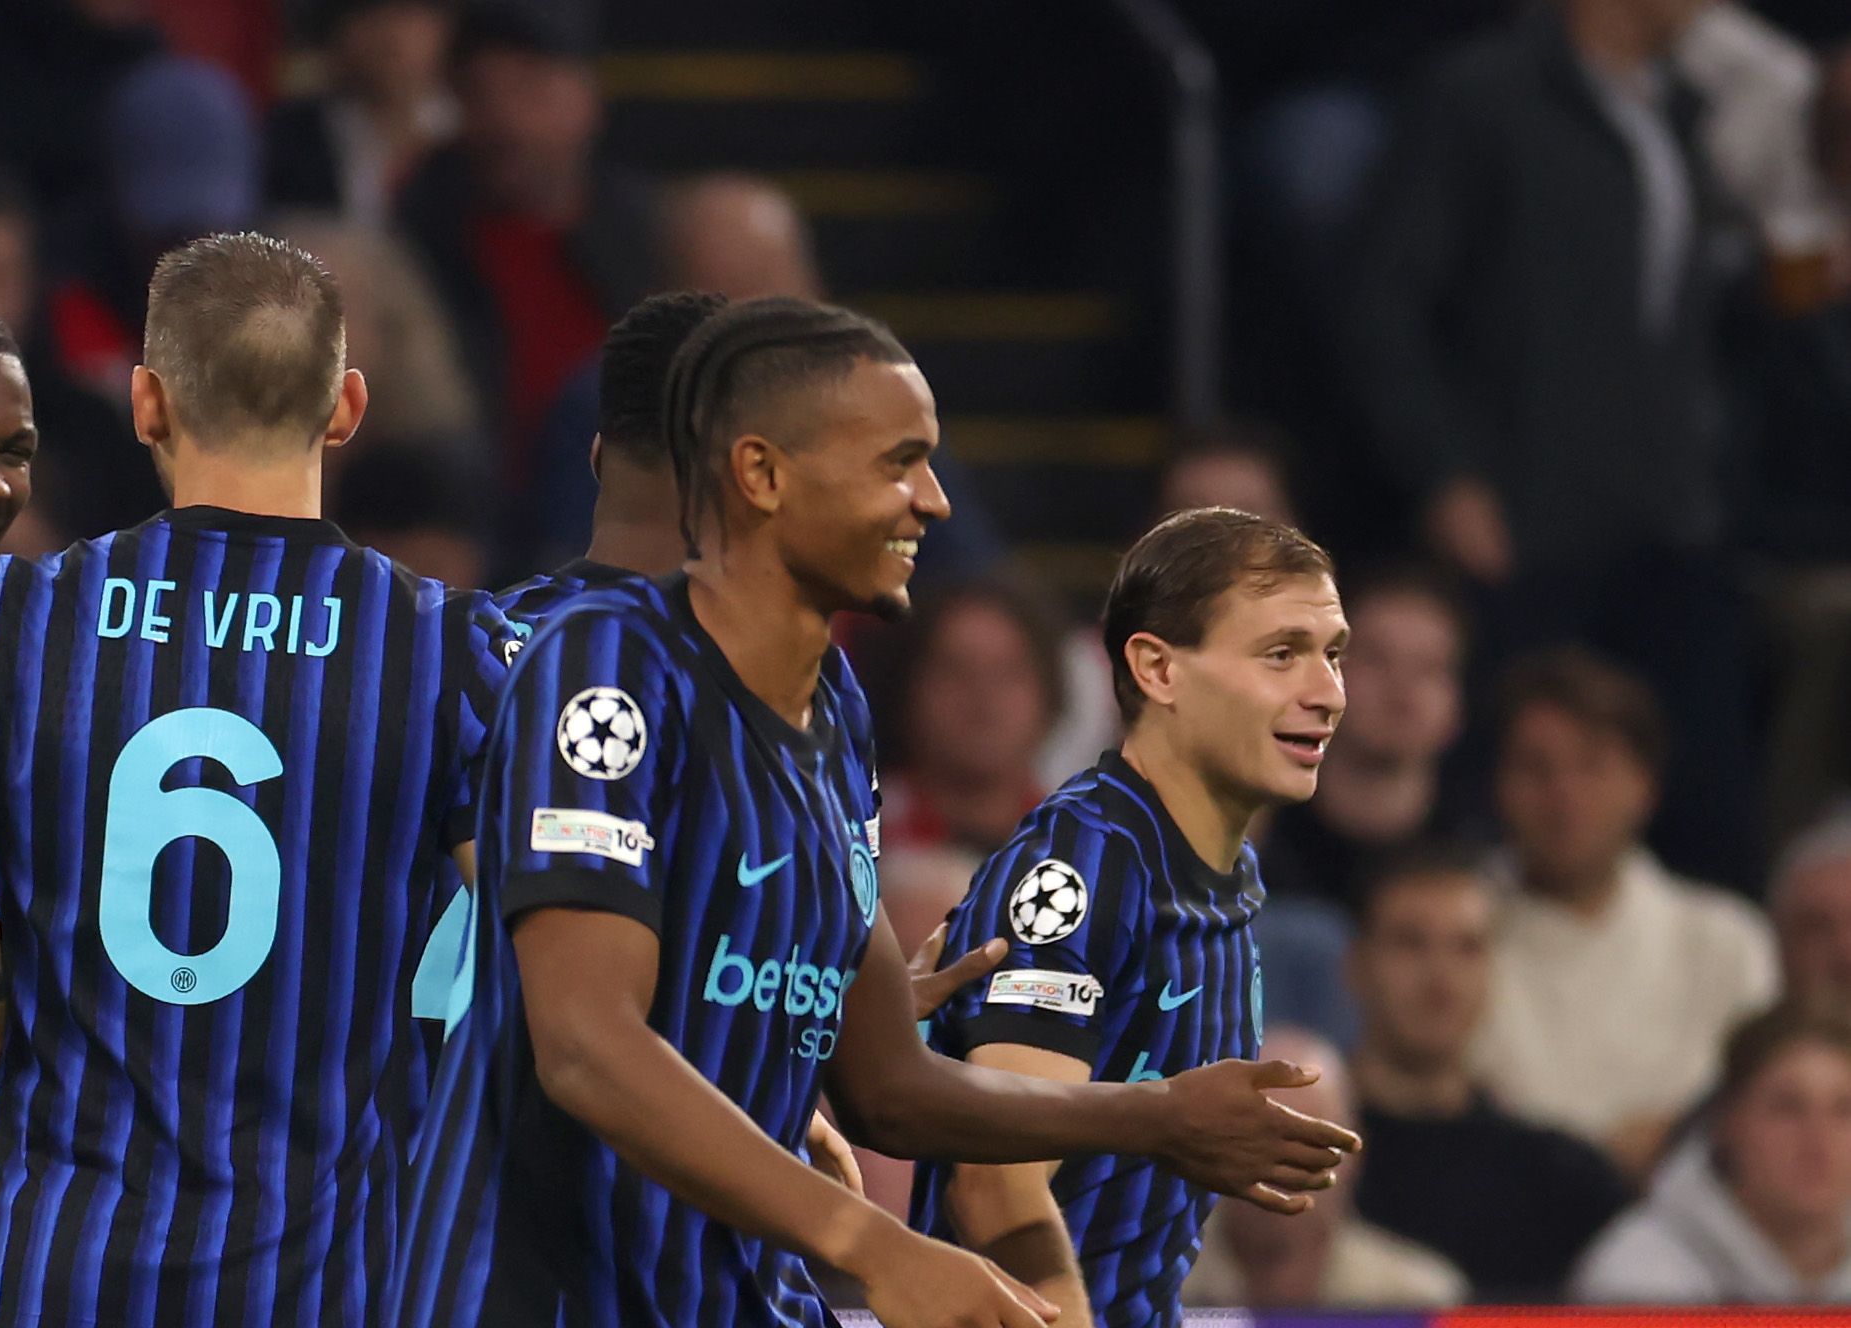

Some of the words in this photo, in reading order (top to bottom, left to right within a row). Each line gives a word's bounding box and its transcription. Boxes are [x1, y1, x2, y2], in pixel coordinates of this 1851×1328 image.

[97, 577, 176, 643] DE
[203, 590, 342, 657] VRIJ
[99, 706, 285, 1006] 6
[703, 933, 857, 1023] betss
